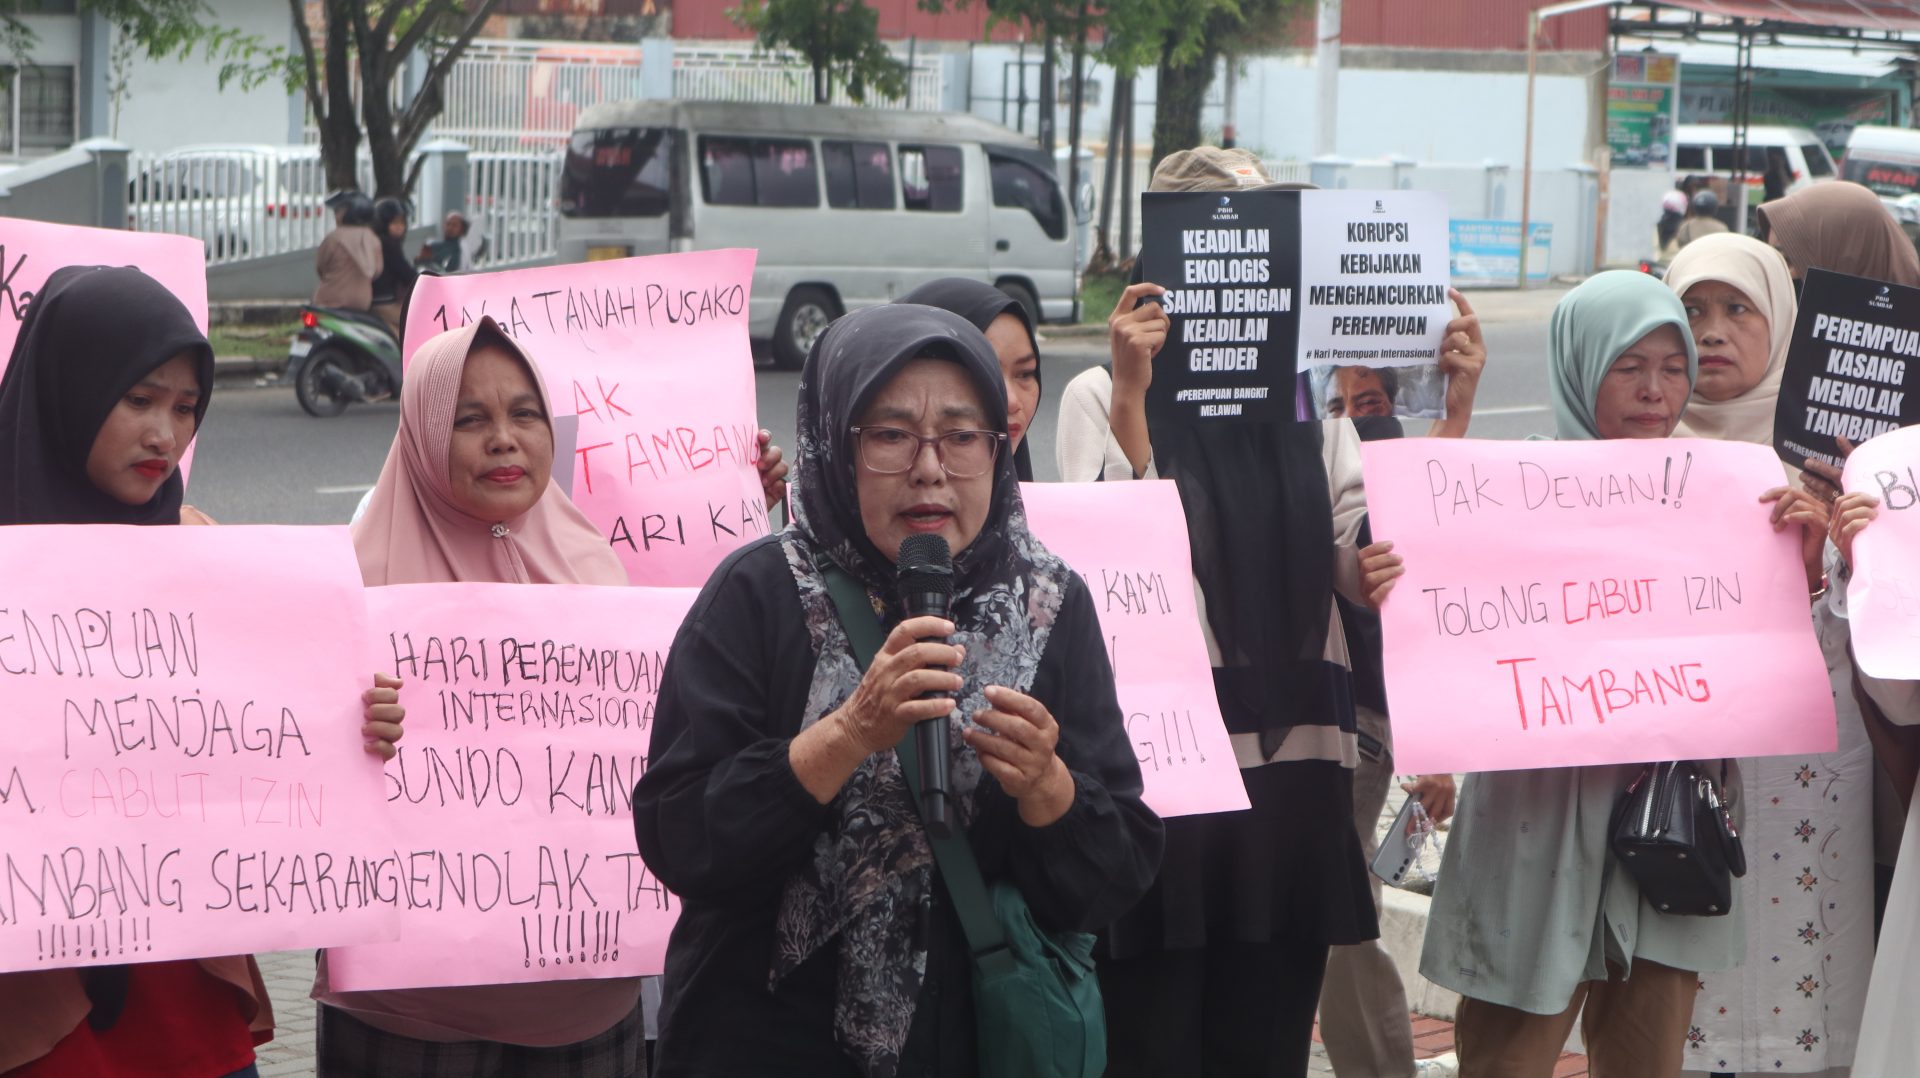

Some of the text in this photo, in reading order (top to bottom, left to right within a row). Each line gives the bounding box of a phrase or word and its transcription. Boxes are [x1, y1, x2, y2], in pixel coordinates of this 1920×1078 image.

[1183, 229, 1270, 254] KEADILAN
[1347, 222, 1409, 243] KORUPSI
[1185, 259, 1270, 284] EKOLOGIS
[1340, 254, 1422, 274] KEBIJAKAN
[532, 287, 636, 335] TANAH
[646, 284, 744, 327] PUSAKO
[1163, 288, 1292, 314] SAMA DENGAN
[1309, 285, 1445, 305] MENGHANCURKAN
[1183, 318, 1269, 343] KEADILAN
[1331, 316, 1427, 336] PEREMPUAN
[1812, 313, 1920, 358] PEREMPUA
[1190, 347, 1259, 372] GENDER
[1314, 350, 1331, 359] Hari
[1332, 350, 1380, 362] Perempuan
[1381, 349, 1436, 360] Internasional
[1826, 348, 1906, 386] KASANG
[1177, 387, 1269, 401] #PEREMPUAN BANGKIT
[1200, 404, 1242, 416] MELAWAN
[1808, 376, 1905, 416] MENOLAK
[1783, 440, 1833, 465] #PEREMPUAN
[1427, 459, 1503, 526] PAK
[1102, 569, 1171, 614] KAMI
[1423, 572, 1742, 636] TOLONG CABUT IZIN
[390, 632, 488, 684] HARI
[1497, 657, 1711, 730] TAMBANG
[64, 689, 311, 759] MENJAGA
[60, 767, 209, 822] CABUT
[240, 775, 323, 828] IZIN
[546, 745, 649, 816] KAN
[0, 844, 398, 924] MBANG SEKARANG
[606, 853, 669, 913] TA
